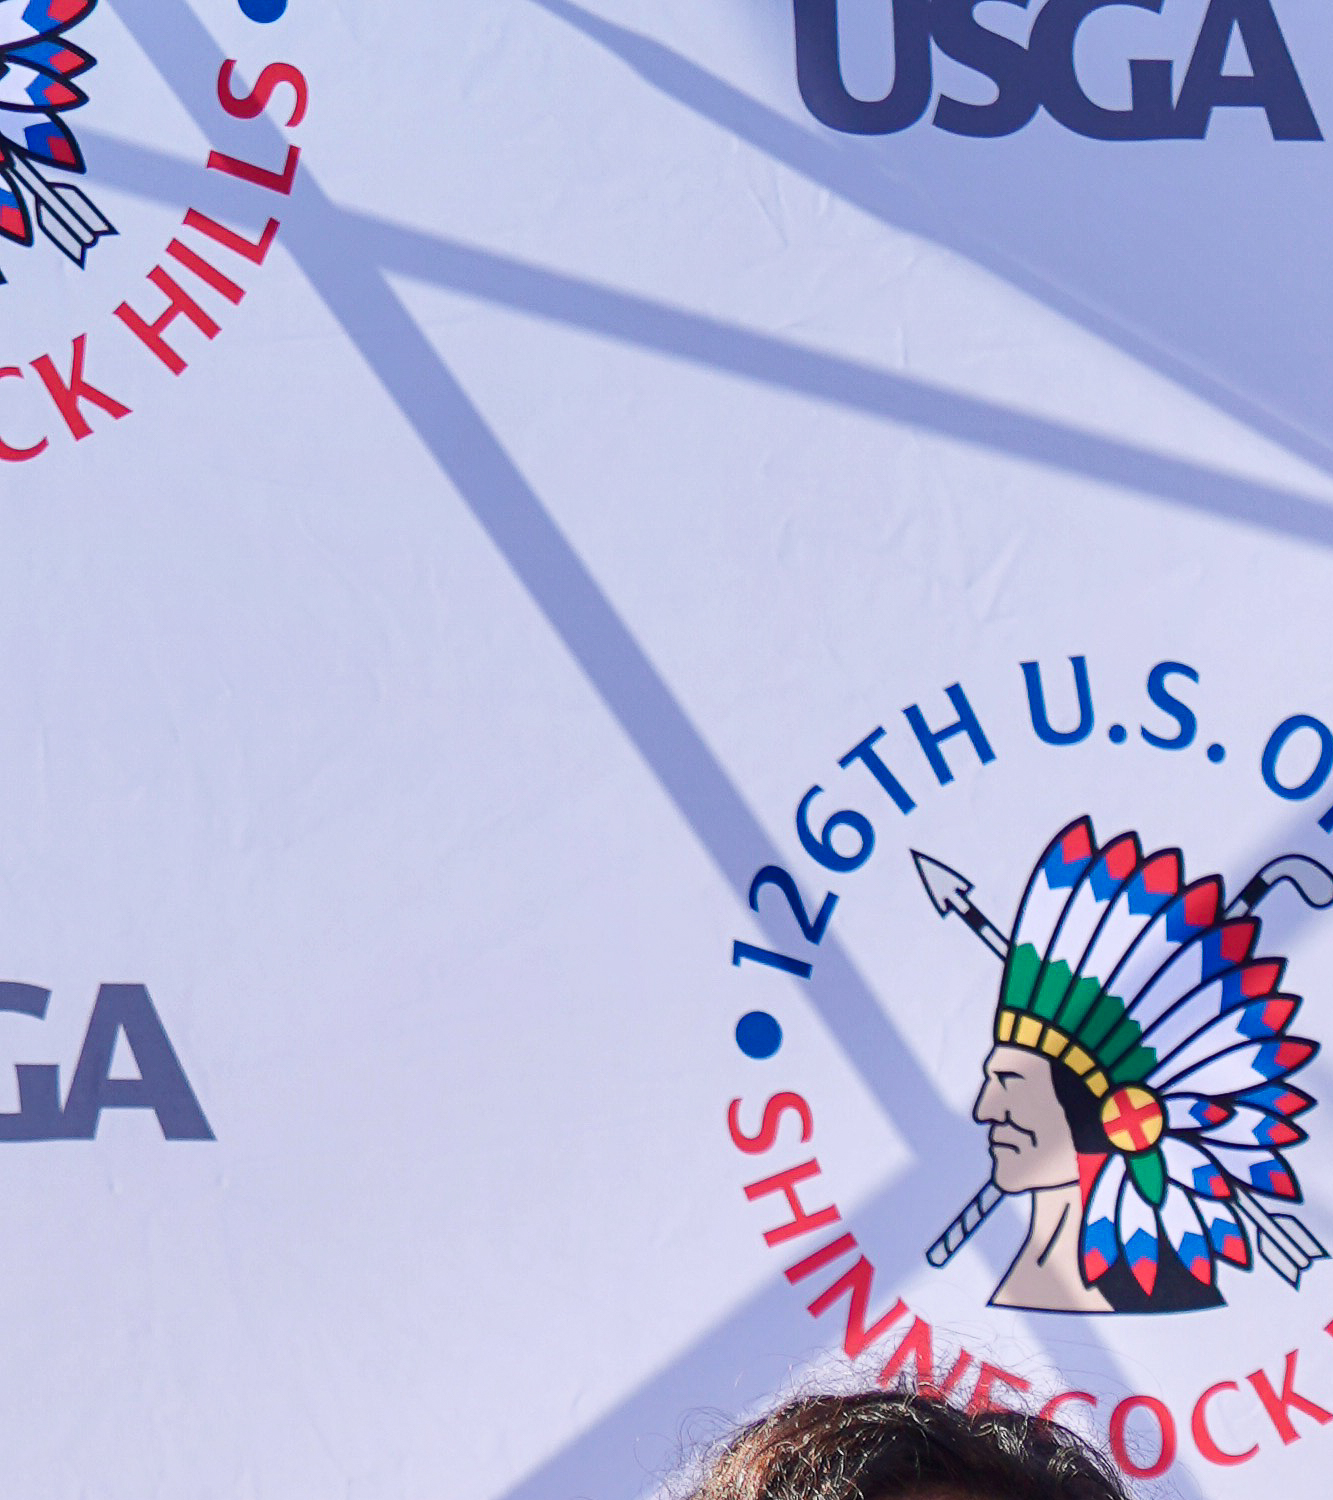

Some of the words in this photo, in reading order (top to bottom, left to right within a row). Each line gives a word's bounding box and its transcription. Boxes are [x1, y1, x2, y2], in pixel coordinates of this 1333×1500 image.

[113, 57, 308, 376] HILLS
[792, 0, 1325, 142] USGA
[732, 682, 997, 981] 126TH
[1020, 655, 1226, 764] U.S.
